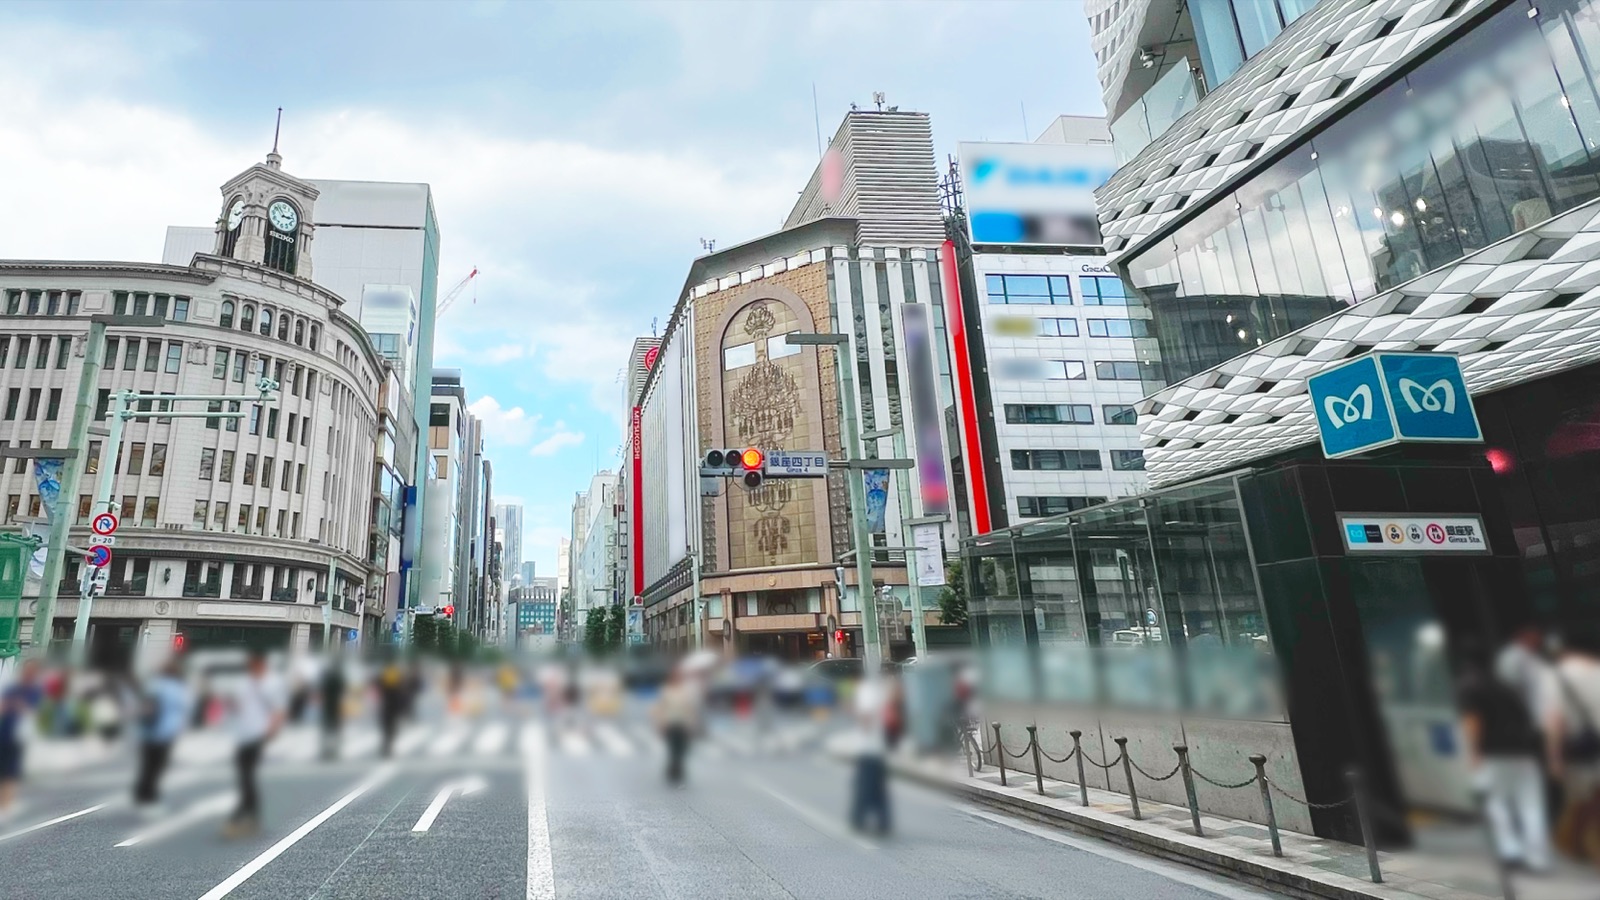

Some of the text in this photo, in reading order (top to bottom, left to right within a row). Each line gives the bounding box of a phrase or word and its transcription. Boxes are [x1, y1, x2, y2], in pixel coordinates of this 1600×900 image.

[270, 230, 294, 243] SEIKO
[770, 457, 824, 467] 銀座四丁目
